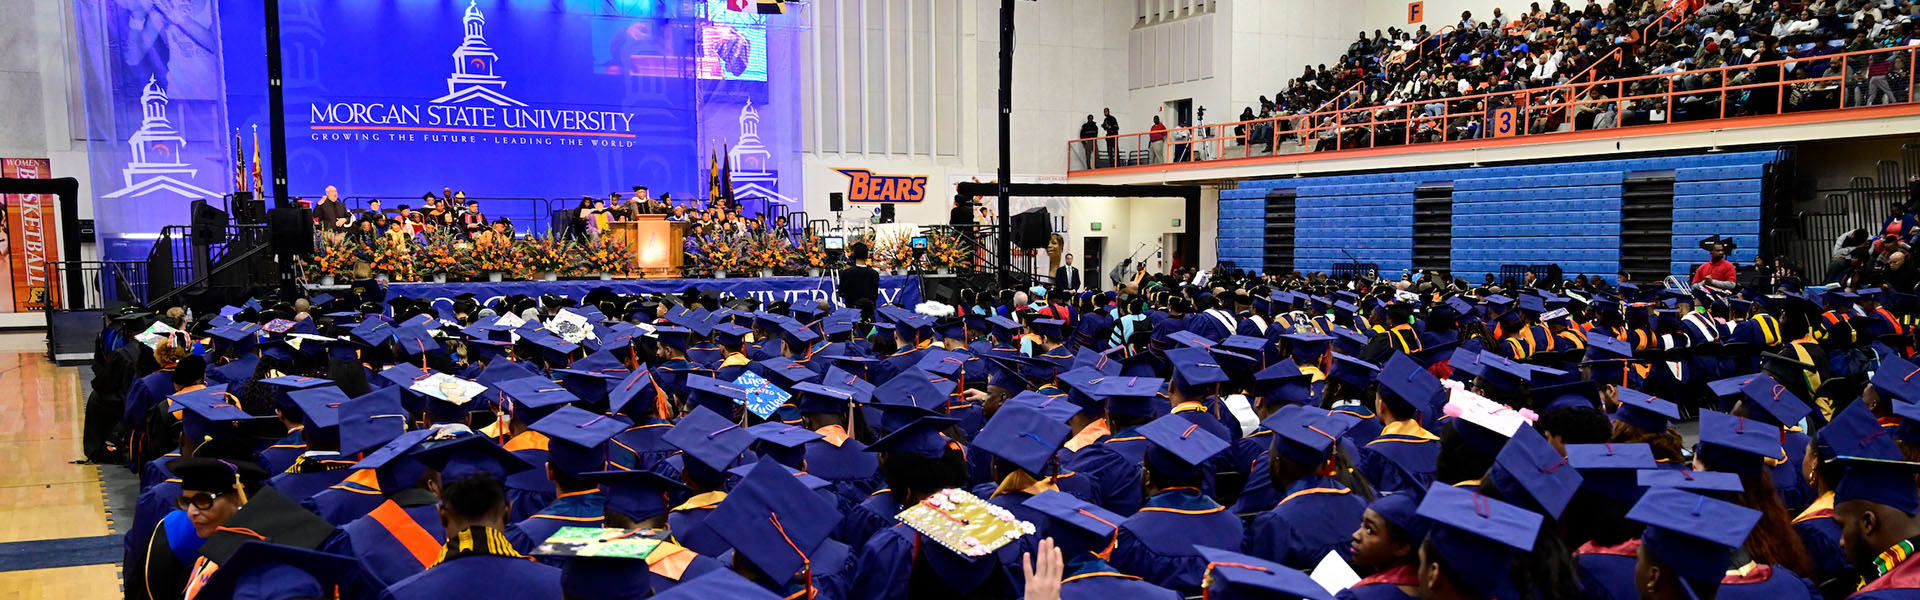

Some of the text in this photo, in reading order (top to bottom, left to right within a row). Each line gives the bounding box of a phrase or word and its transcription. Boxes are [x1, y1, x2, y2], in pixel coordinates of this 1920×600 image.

[1411, 4, 1420, 22] F
[310, 102, 635, 132] MORGAN STATE UNIVERSITY
[1499, 111, 1512, 134] 3
[311, 133, 380, 141] GROWING
[389, 133, 415, 142] THE
[424, 134, 476, 143] FUTURE
[494, 136, 552, 146] LEADING
[560, 138, 583, 146] THE
[6, 158, 48, 167] WOMEN'S
[838, 170, 928, 203] BEARS
[19, 167, 46, 286] BSKETBALL
